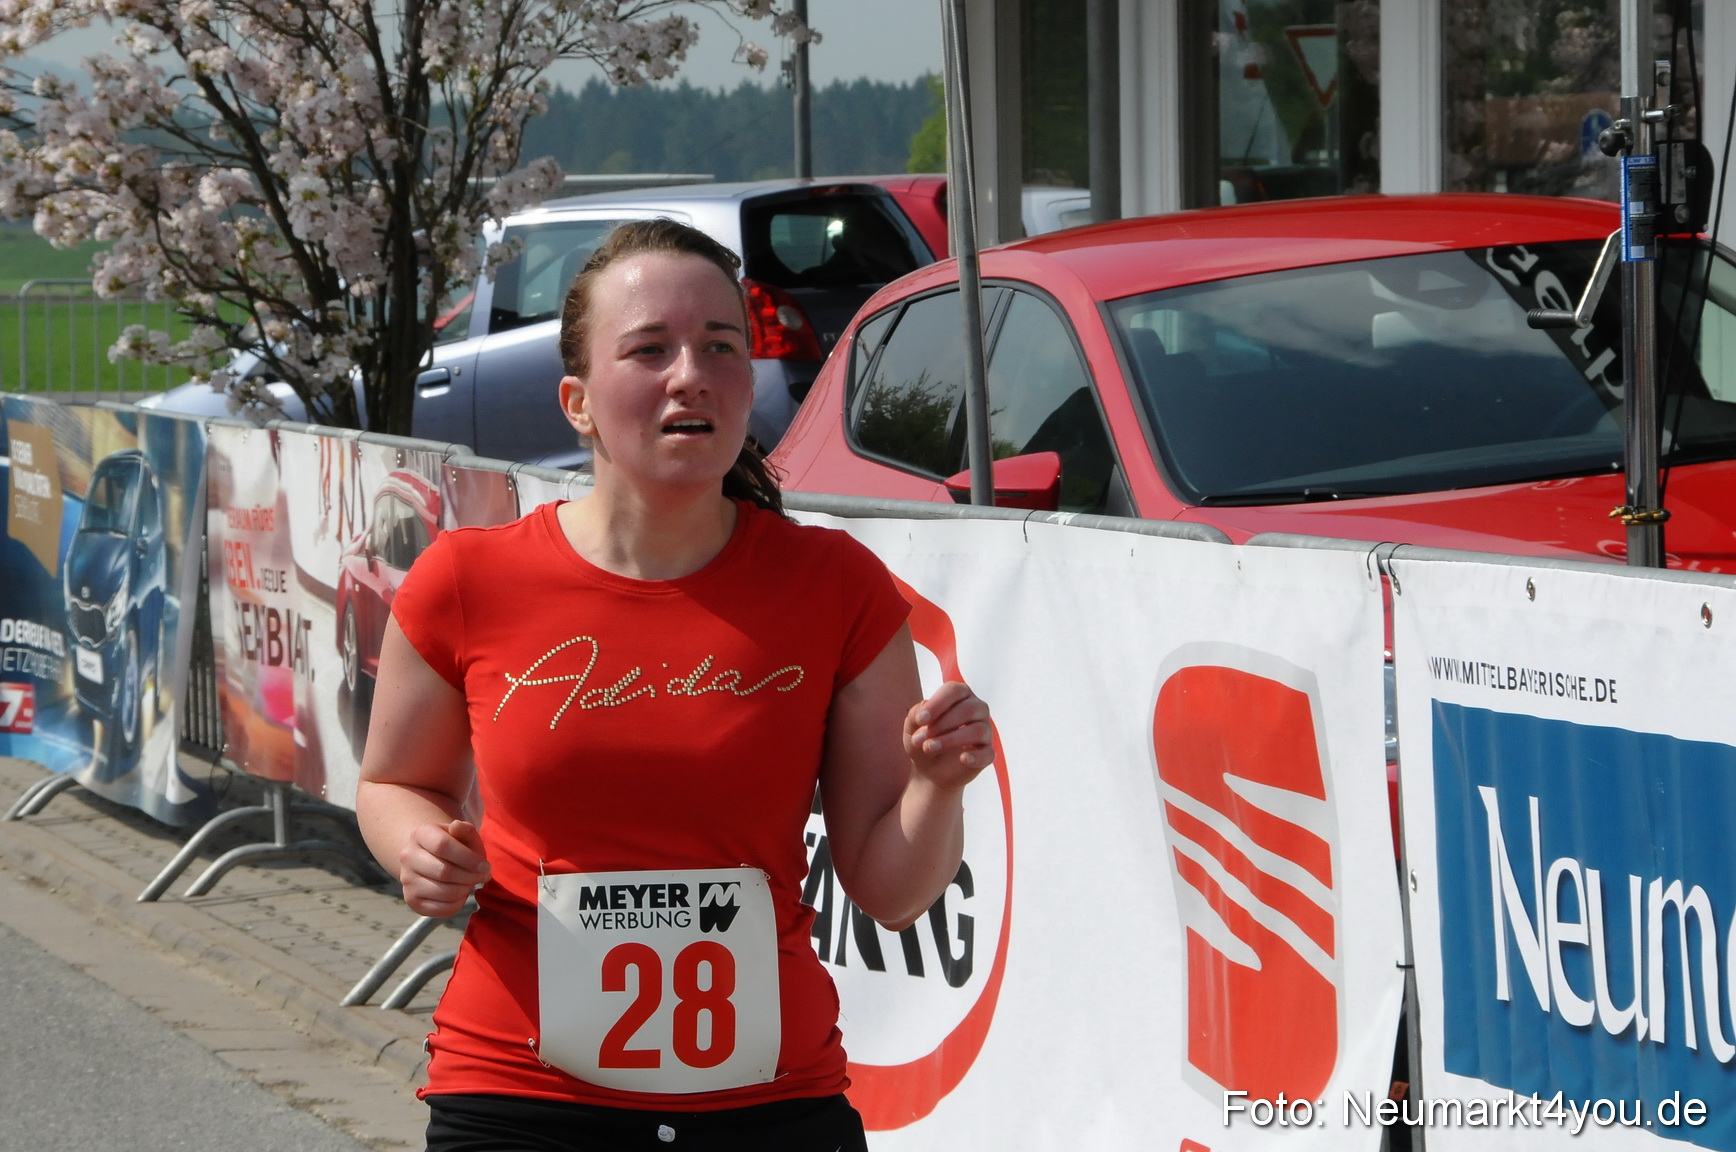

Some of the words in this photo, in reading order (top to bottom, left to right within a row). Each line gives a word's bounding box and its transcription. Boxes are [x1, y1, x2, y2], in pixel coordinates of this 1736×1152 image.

[492, 635, 804, 731] Adidas
[578, 883, 690, 911] MEYER
[579, 910, 692, 931] WERBUNG
[1477, 785, 1736, 1065] Neum
[598, 940, 736, 1069] 28
